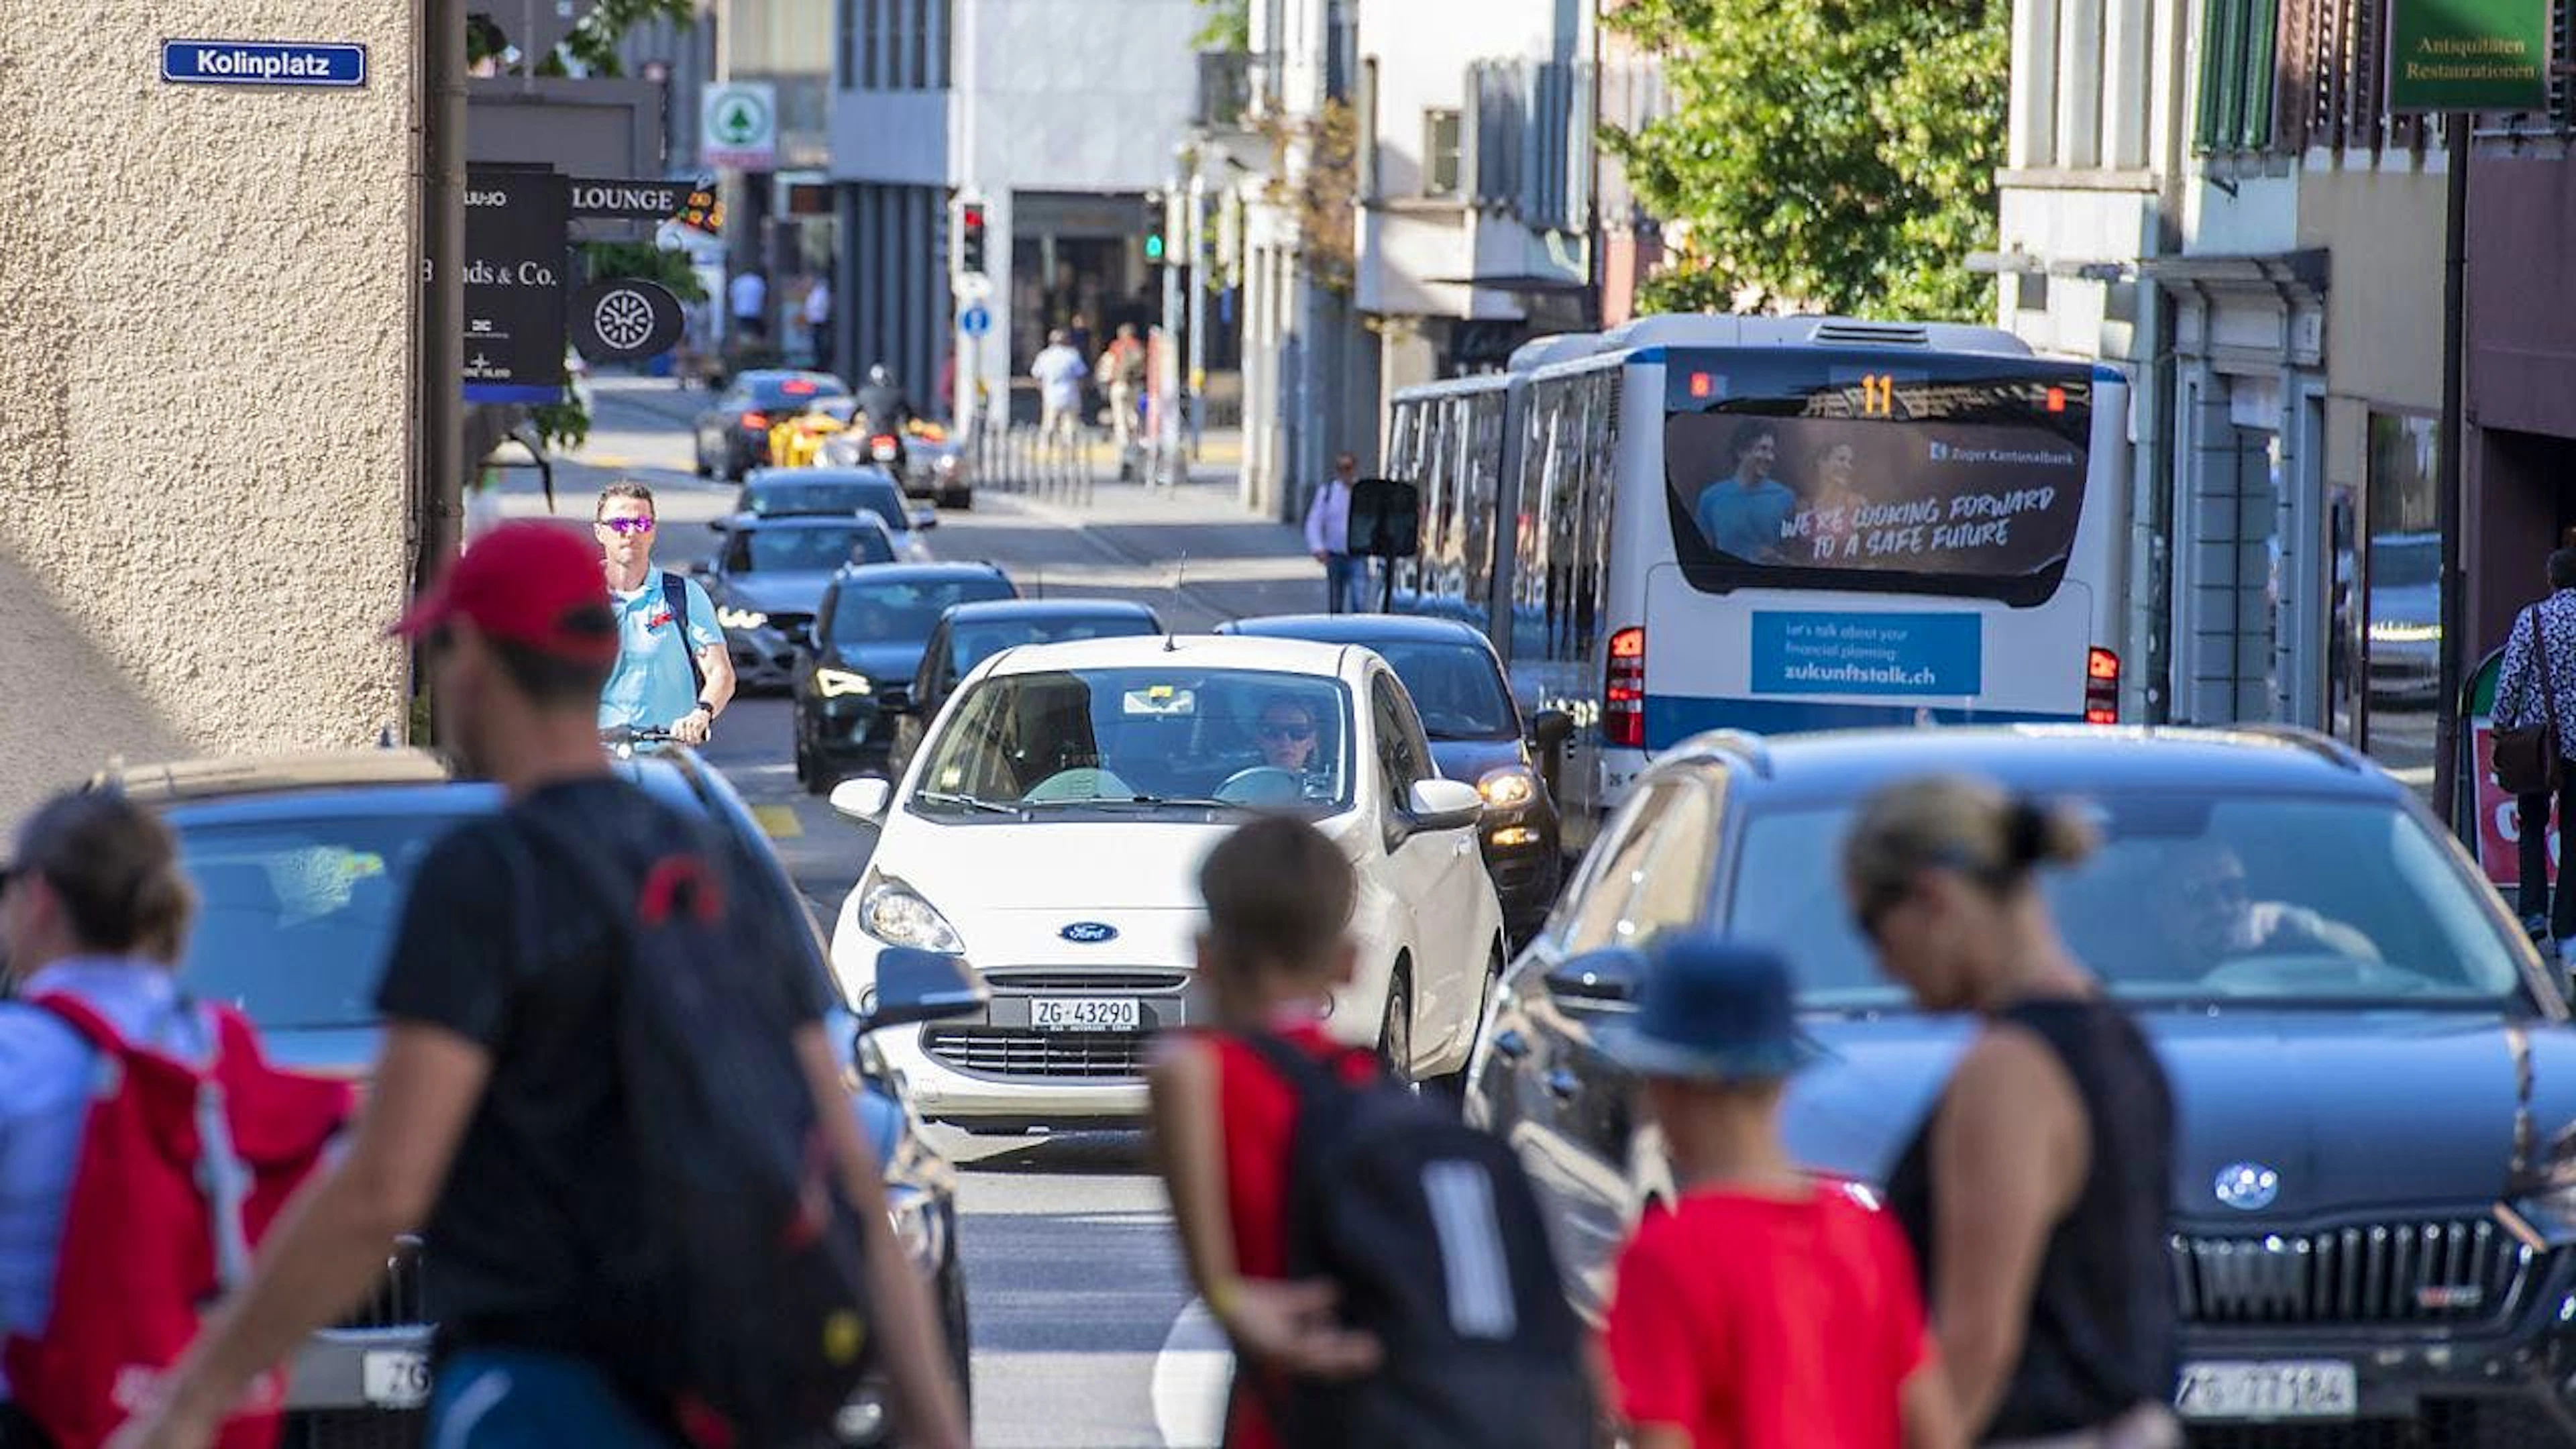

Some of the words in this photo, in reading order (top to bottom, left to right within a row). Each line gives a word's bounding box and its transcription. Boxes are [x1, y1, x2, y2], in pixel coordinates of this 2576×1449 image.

[2418, 37, 2525, 57] Antiquitäten
[197, 49, 329, 80] Kolinplatz
[2406, 62, 2536, 80] Restaurationen
[572, 187, 674, 211] LOUNGE
[498, 268, 513, 285] &
[518, 261, 557, 285] Co.
[1862, 373, 1892, 415] 11
[1952, 448, 1986, 462] Zuger
[1990, 450, 2074, 465] Kantonalbank
[1853, 499, 1939, 527] LOOKING
[1948, 485, 2055, 520] FORWARD
[1813, 536, 1835, 560] TO
[1844, 534, 1860, 557] A
[1866, 527, 1925, 557] SAFE
[1931, 520, 2010, 551] FUTURE
[1815, 622, 1837, 637] talk
[1840, 624, 1877, 639] about
[1880, 629, 1909, 642] your
[1785, 639, 1839, 656] financial
[1784, 662, 1935, 684] zukunftstalk.ch
[1069, 924, 1108, 939] Ford
